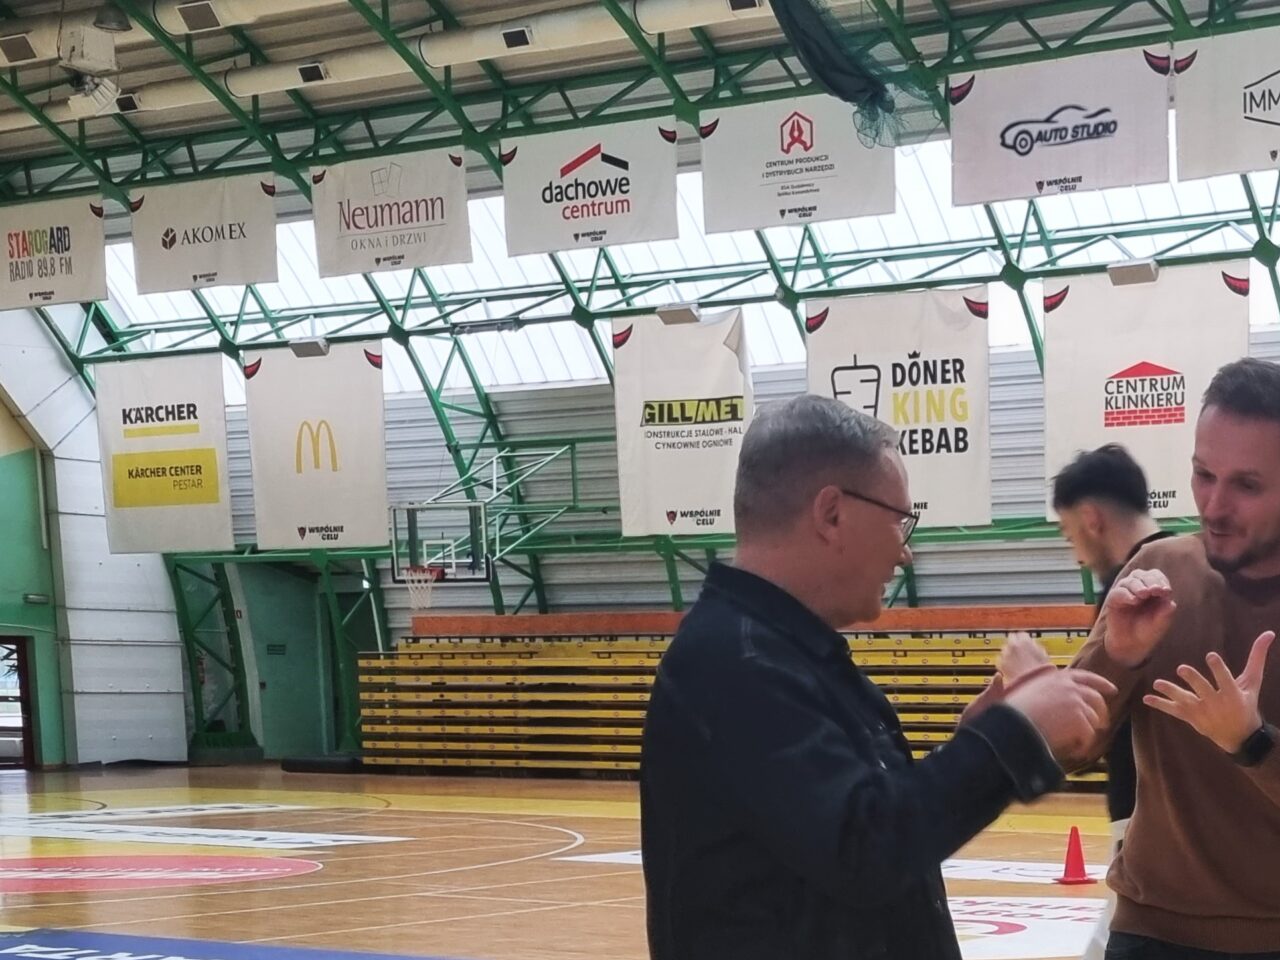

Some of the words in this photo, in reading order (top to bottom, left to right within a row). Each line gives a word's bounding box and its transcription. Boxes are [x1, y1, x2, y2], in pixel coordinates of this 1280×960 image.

[1034, 126, 1069, 144] AUTO
[1070, 119, 1118, 140] STUDIO
[541, 176, 630, 204] dachowe
[338, 196, 445, 233] Neumann
[562, 199, 630, 220] centrum
[7, 226, 71, 260] STAROGARD
[180, 222, 247, 246] AKOMEX
[351, 239, 382, 251] OKNA
[391, 232, 427, 248] DRZWI
[9, 259, 34, 283] RADIO
[60, 256, 73, 276] FM
[1104, 375, 1186, 395] CENTRUM
[891, 387, 970, 426] KING
[1104, 391, 1186, 411] KLINKIERU
[121, 403, 199, 425] KÄRCHER
[645, 430, 693, 439] ONSTRUKCJE
[128, 467, 168, 479] KÄRCHER
[169, 464, 203, 477] CENTER
[172, 478, 204, 490] PESTAR
